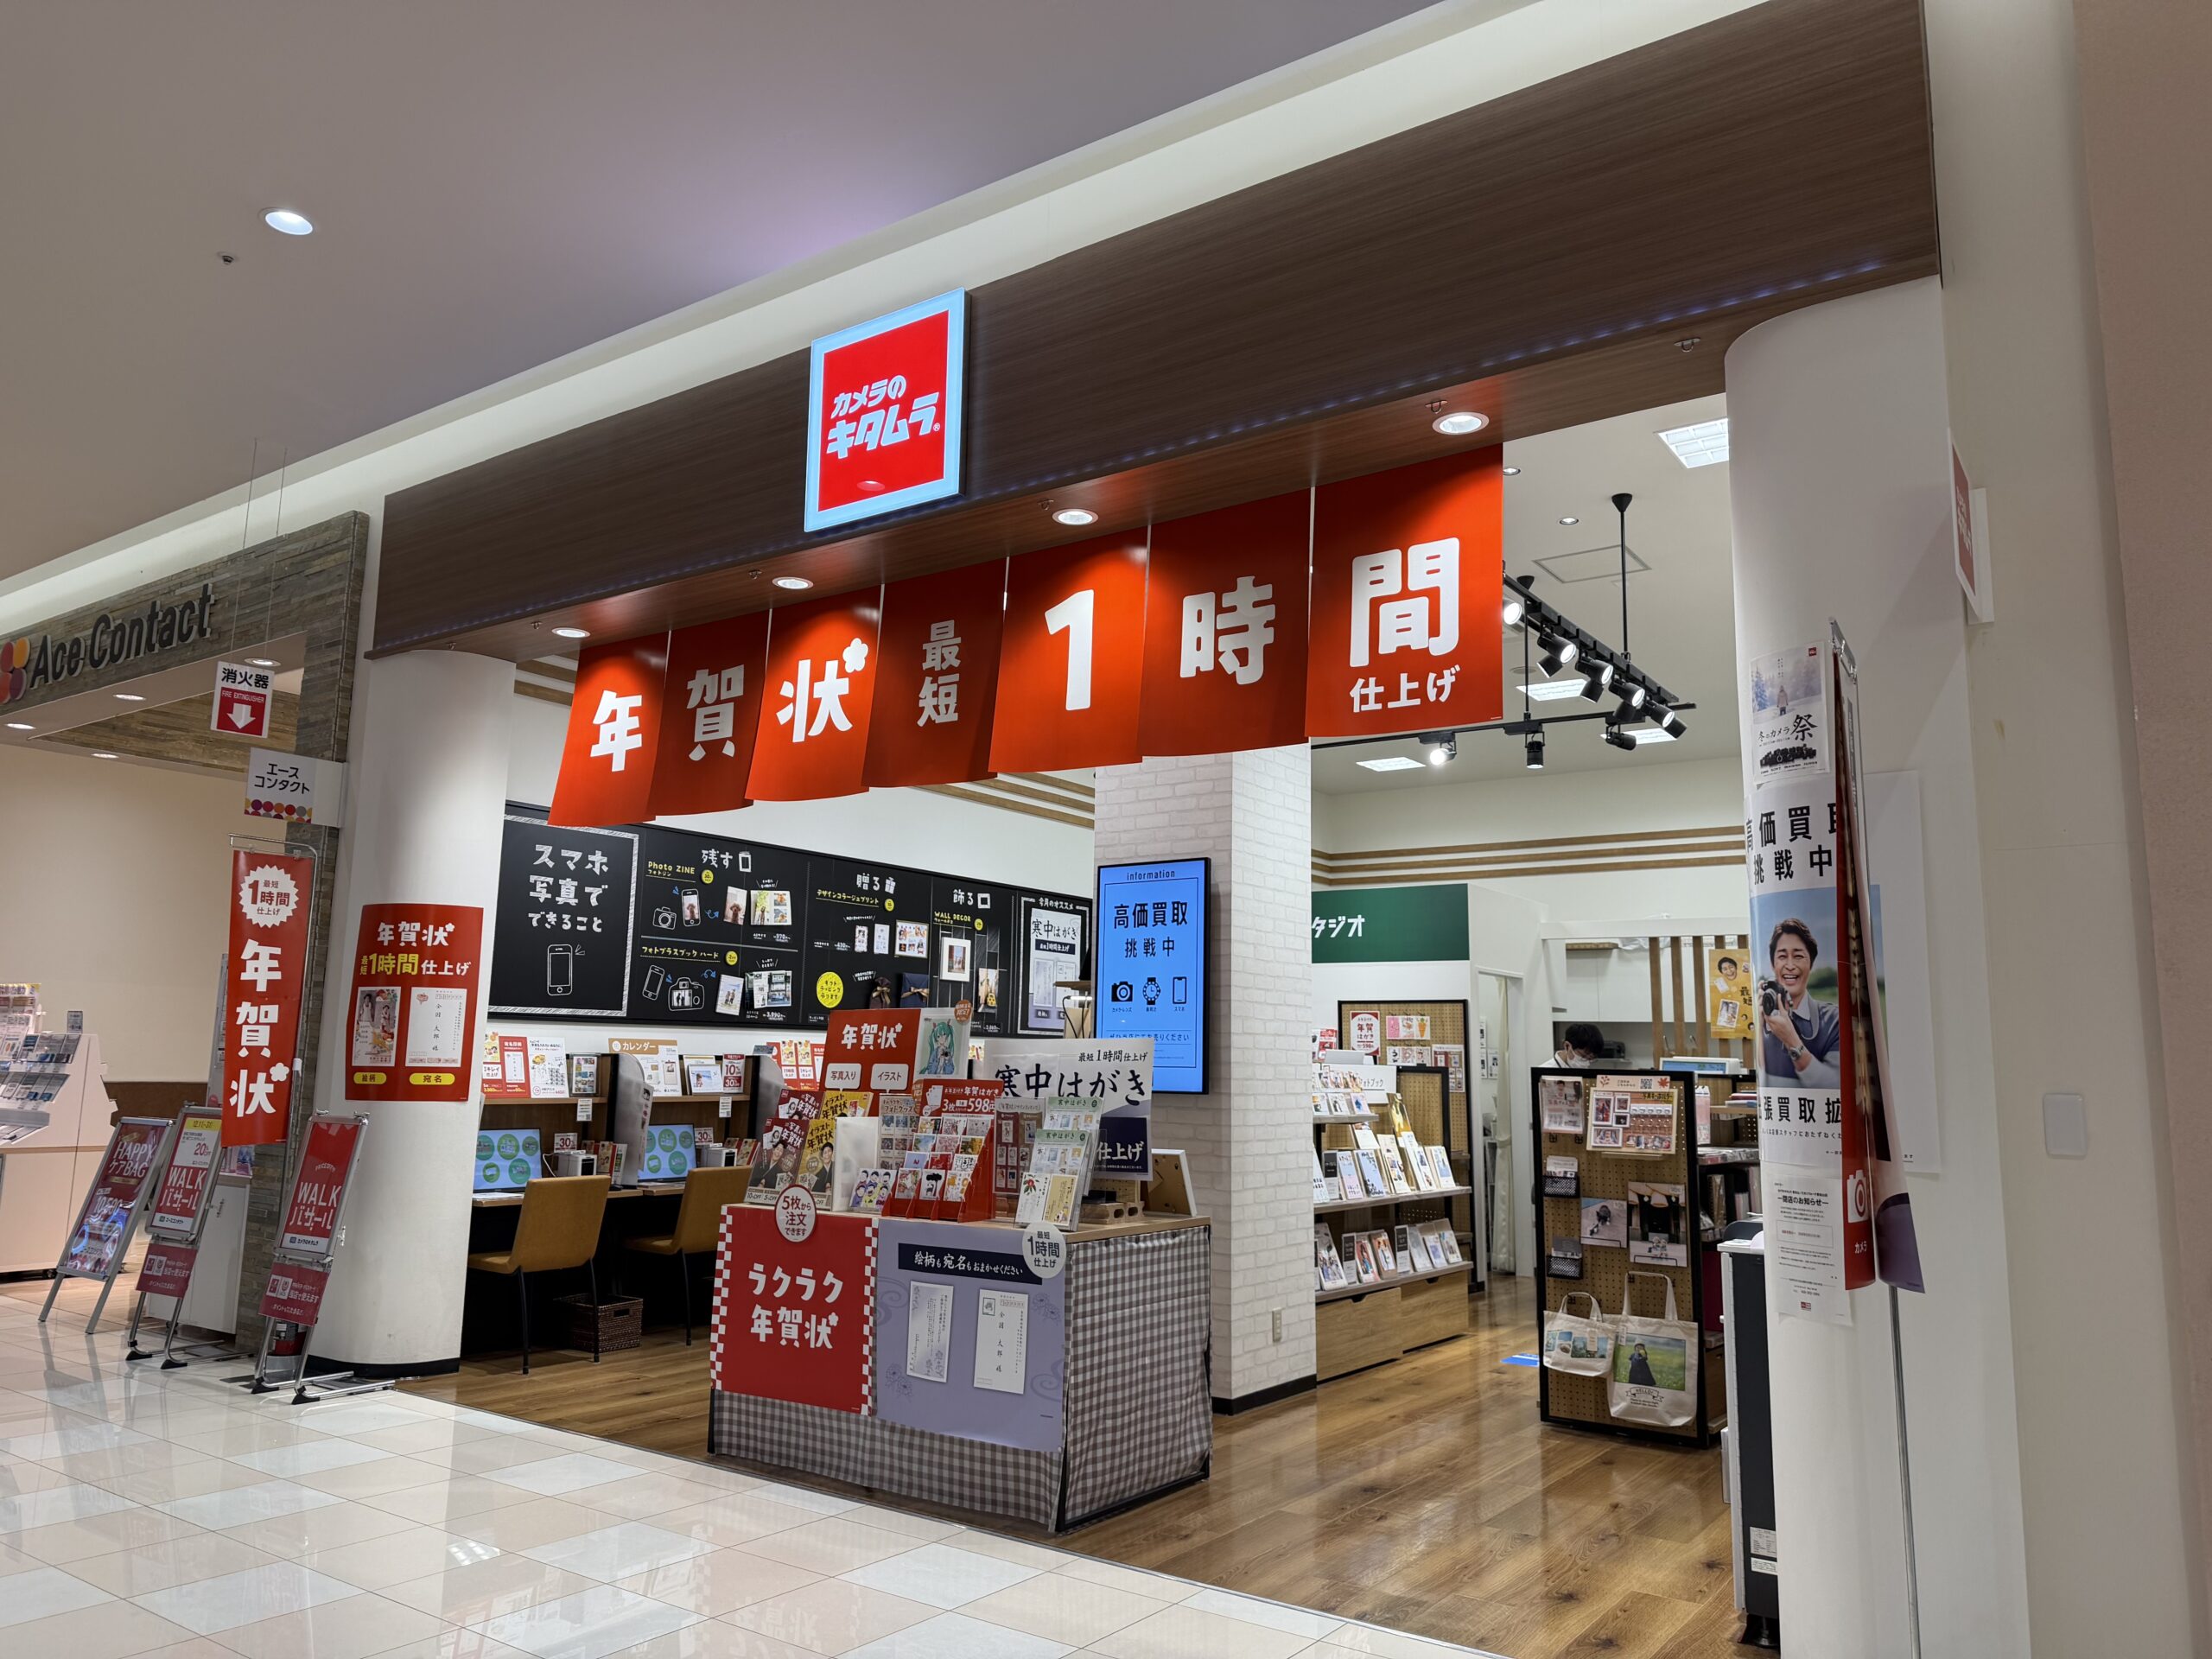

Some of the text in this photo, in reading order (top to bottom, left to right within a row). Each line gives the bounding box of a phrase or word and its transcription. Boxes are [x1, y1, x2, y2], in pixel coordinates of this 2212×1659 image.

[830, 375, 907, 419] カメラの
[29, 582, 215, 690] Ace Contact
[221, 667, 270, 690] 消火器
[233, 692, 264, 703] EXTINGUISHER
[1349, 664, 1461, 714] 仕上げ
[266, 763, 300, 779] エース
[254, 775, 310, 795] コンタクト
[532, 844, 609, 875] スマホ
[648, 861, 673, 872] Photo
[701, 849, 734, 869] 残す
[1754, 844, 1833, 885] 挑戦中
[262, 879, 280, 889] 最短
[856, 872, 880, 891] 贈る
[1127, 869, 1175, 881] information
[247, 879, 290, 906] 1時間
[529, 874, 609, 906] 写真で
[952, 889, 974, 906] 飾る
[256, 906, 281, 917] 仕上げ
[1038, 897, 1074, 911] 今月のオススメ
[528, 911, 603, 933] できること
[934, 911, 971, 922] WALL DECOR
[1113, 900, 1189, 930] 高価買取
[377, 920, 455, 948] 年賀状
[1032, 918, 1077, 940] 寒中はがき
[1124, 936, 1176, 958] 挑戦中
[229, 938, 290, 1118] 年賀状
[841, 1022, 903, 1051] 年賀状
[622, 1041, 657, 1051] カレンダー
[422, 1074, 443, 1084] 宛名
[830, 1071, 856, 1081] 写真入り
[877, 1071, 902, 1082] イラスト
[995, 1063, 1147, 1107] 寒中はがき
[964, 1086, 1000, 1096] 年賀はがき
[781, 1128, 804, 1149] 年賀状
[807, 1129, 835, 1149] 年賀状
[809, 1122, 830, 1136] イラスト
[113, 1141, 157, 1161] HAPPY
[1096, 1141, 1145, 1162] 仕上げ
[108, 1160, 149, 1178] ケアBAG
[167, 1166, 207, 1190] WALK
[160, 1189, 200, 1211] バザール
[296, 1181, 341, 1208] WALK
[781, 1195, 811, 1211] 5枚から
[289, 1205, 334, 1231] バザール
[785, 1211, 807, 1227] 注文
[785, 1227, 807, 1236] できます
[1037, 1231, 1051, 1240] 最短
[1027, 1236, 1060, 1258] 1時間
[913, 1251, 1024, 1276] 絵柄も宛名もおまかせください
[1033, 1257, 1057, 1268] 仕上げ
[748, 1262, 844, 1304] ラクラク
[750, 1303, 840, 1350] 年賀状
